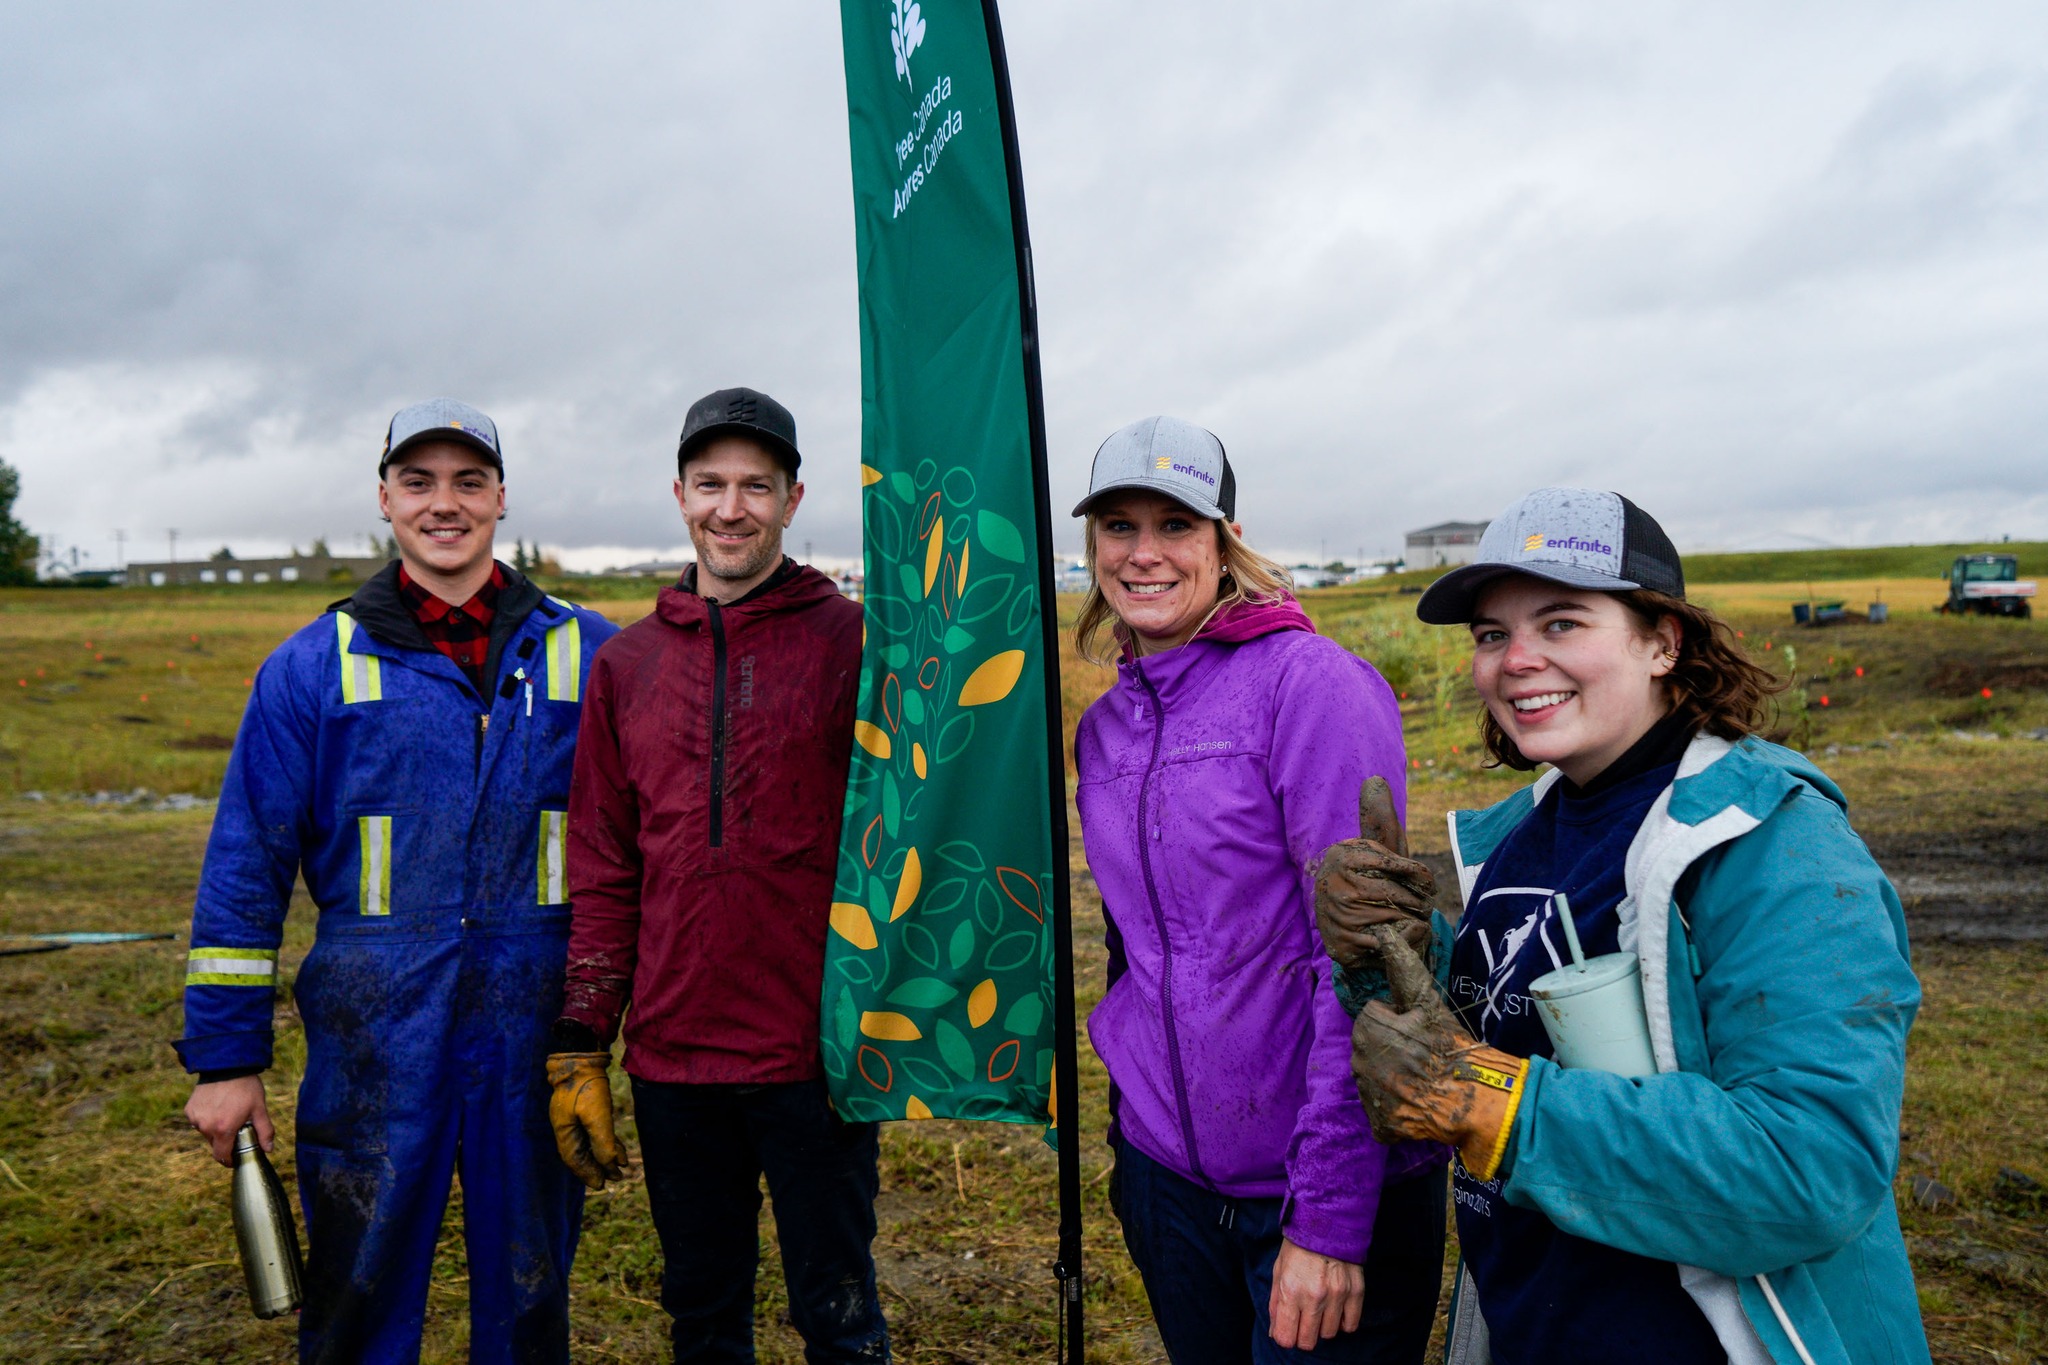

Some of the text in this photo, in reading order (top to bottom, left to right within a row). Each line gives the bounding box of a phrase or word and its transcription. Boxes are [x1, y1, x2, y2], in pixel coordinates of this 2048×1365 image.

[912, 75, 952, 142] Canada
[923, 109, 963, 175] Canada
[1173, 463, 1215, 486] enfinite
[1547, 536, 1612, 556] enfinite
